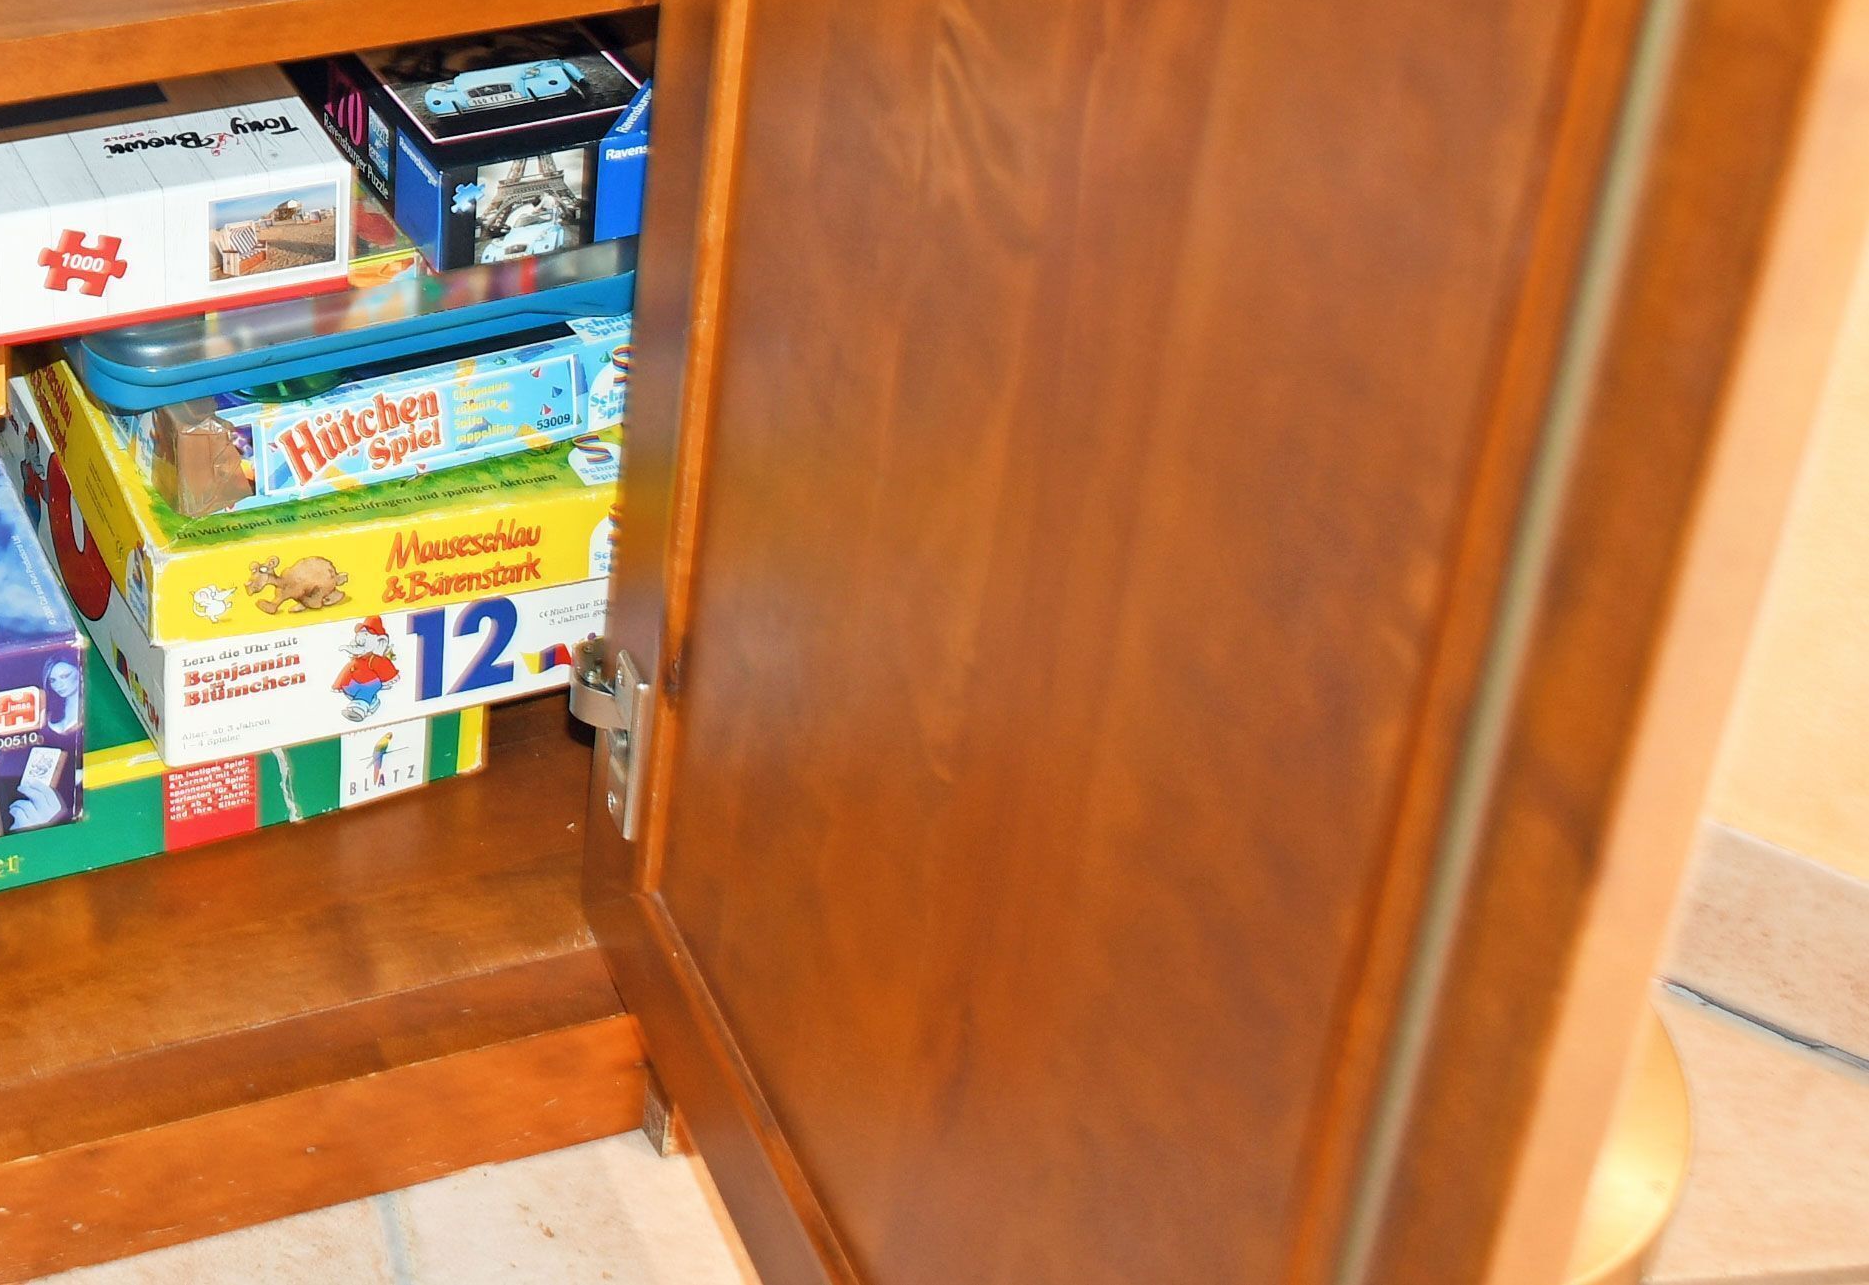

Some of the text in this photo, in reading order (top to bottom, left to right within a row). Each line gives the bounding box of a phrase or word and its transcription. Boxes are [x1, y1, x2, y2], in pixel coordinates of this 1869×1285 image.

[61, 252, 105, 273] 1000
[277, 388, 441, 485] Hütchen
[367, 417, 442, 470] Spiel
[536, 413, 570, 431] 53009
[177, 472, 558, 541] Ein Würfelspiel mit vielen Sachfragen und spaßigen Aktionen
[386, 518, 542, 573] Mauseschlau
[404, 553, 542, 604] Bärenstark
[182, 637, 298, 667] Lern die Uhr mit
[183, 652, 300, 687] Benjamin
[406, 596, 517, 702] 12
[183, 672, 306, 707] Blümchen
[169, 773, 183, 782] Ein
